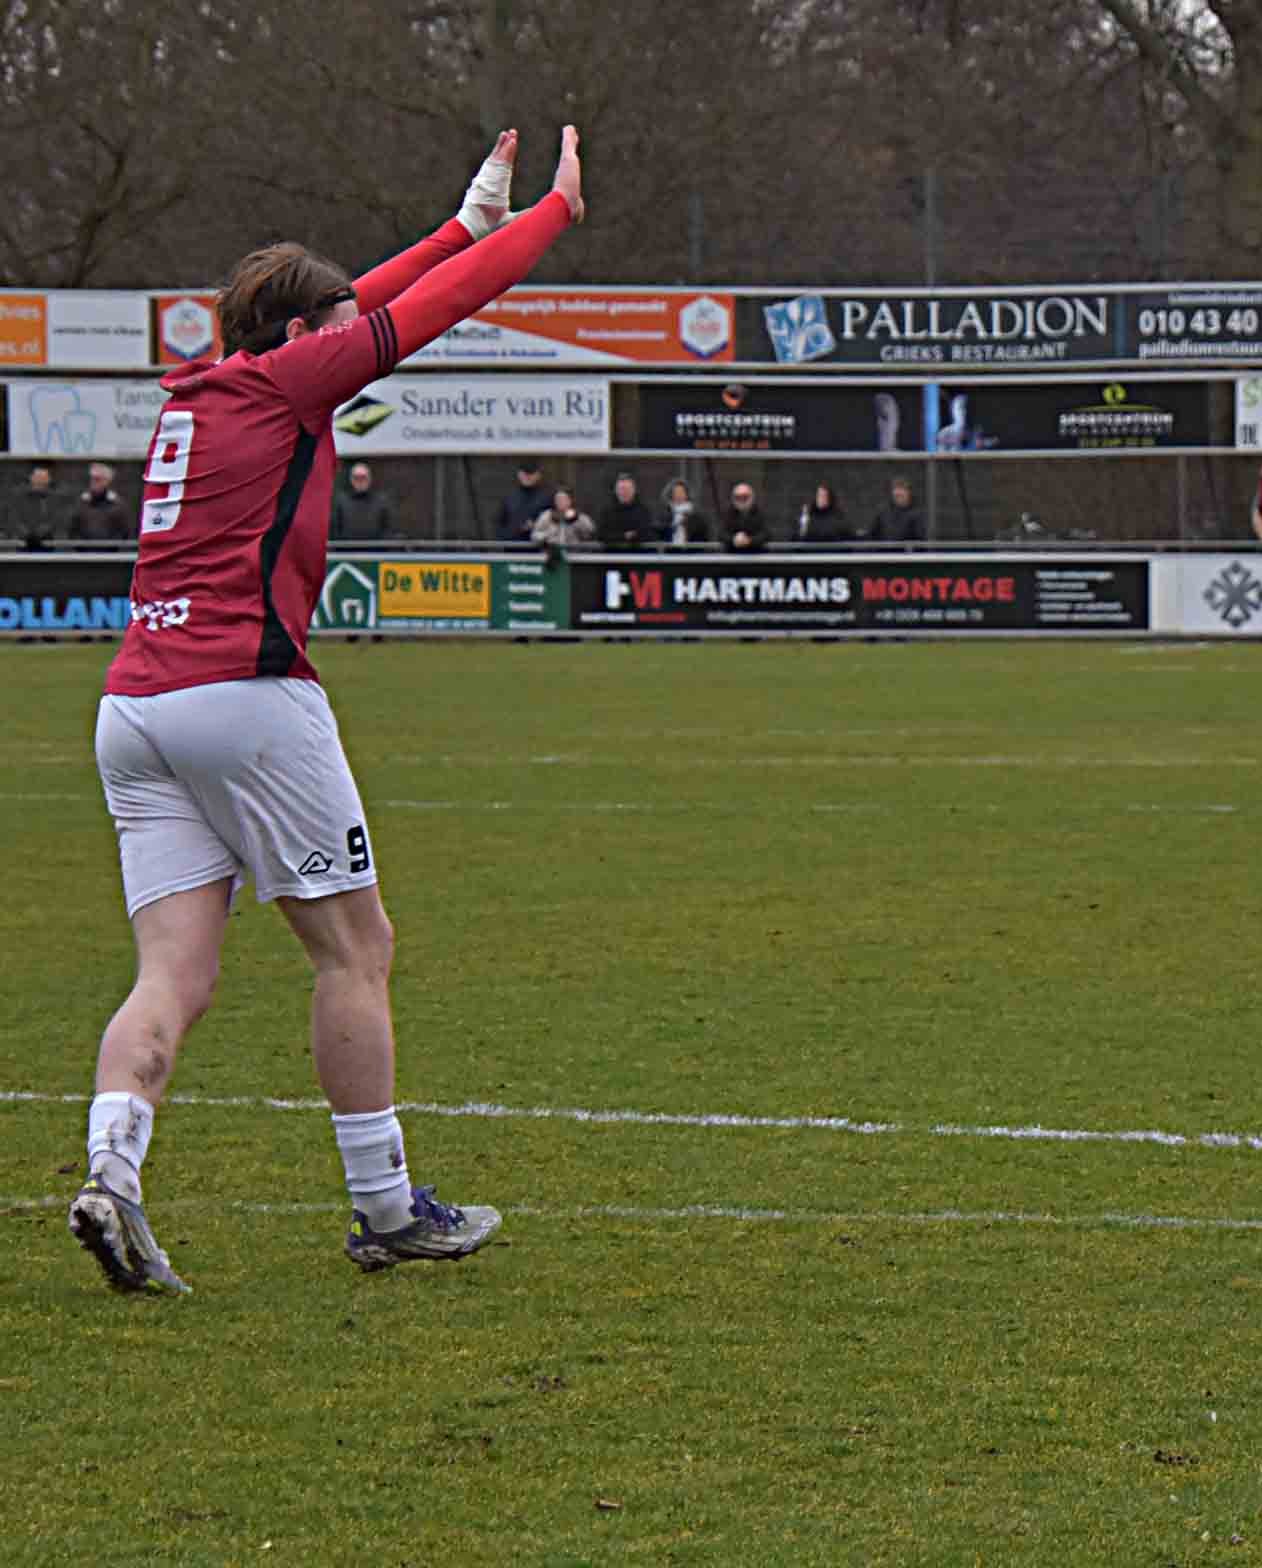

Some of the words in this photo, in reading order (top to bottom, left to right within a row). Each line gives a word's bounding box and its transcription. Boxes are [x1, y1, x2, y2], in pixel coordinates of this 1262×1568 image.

[842, 298, 1107, 339] PALLADION
[1138, 309, 1186, 335] 010
[1190, 309, 1221, 335] 43
[1225, 309, 1259, 335] 40
[880, 345, 944, 361] GRIEKS
[952, 342, 1068, 360] RESTAURANT
[401, 389, 497, 416] Sander
[506, 397, 553, 416] van
[564, 389, 604, 425] Rij
[142, 410, 195, 533] 9
[383, 570, 412, 592] De
[419, 569, 485, 593] Witte
[673, 578, 850, 602] HARTMANS
[862, 577, 1016, 601] MONTAGE
[0, 597, 131, 628] OLLAN
[347, 825, 370, 874] 9
